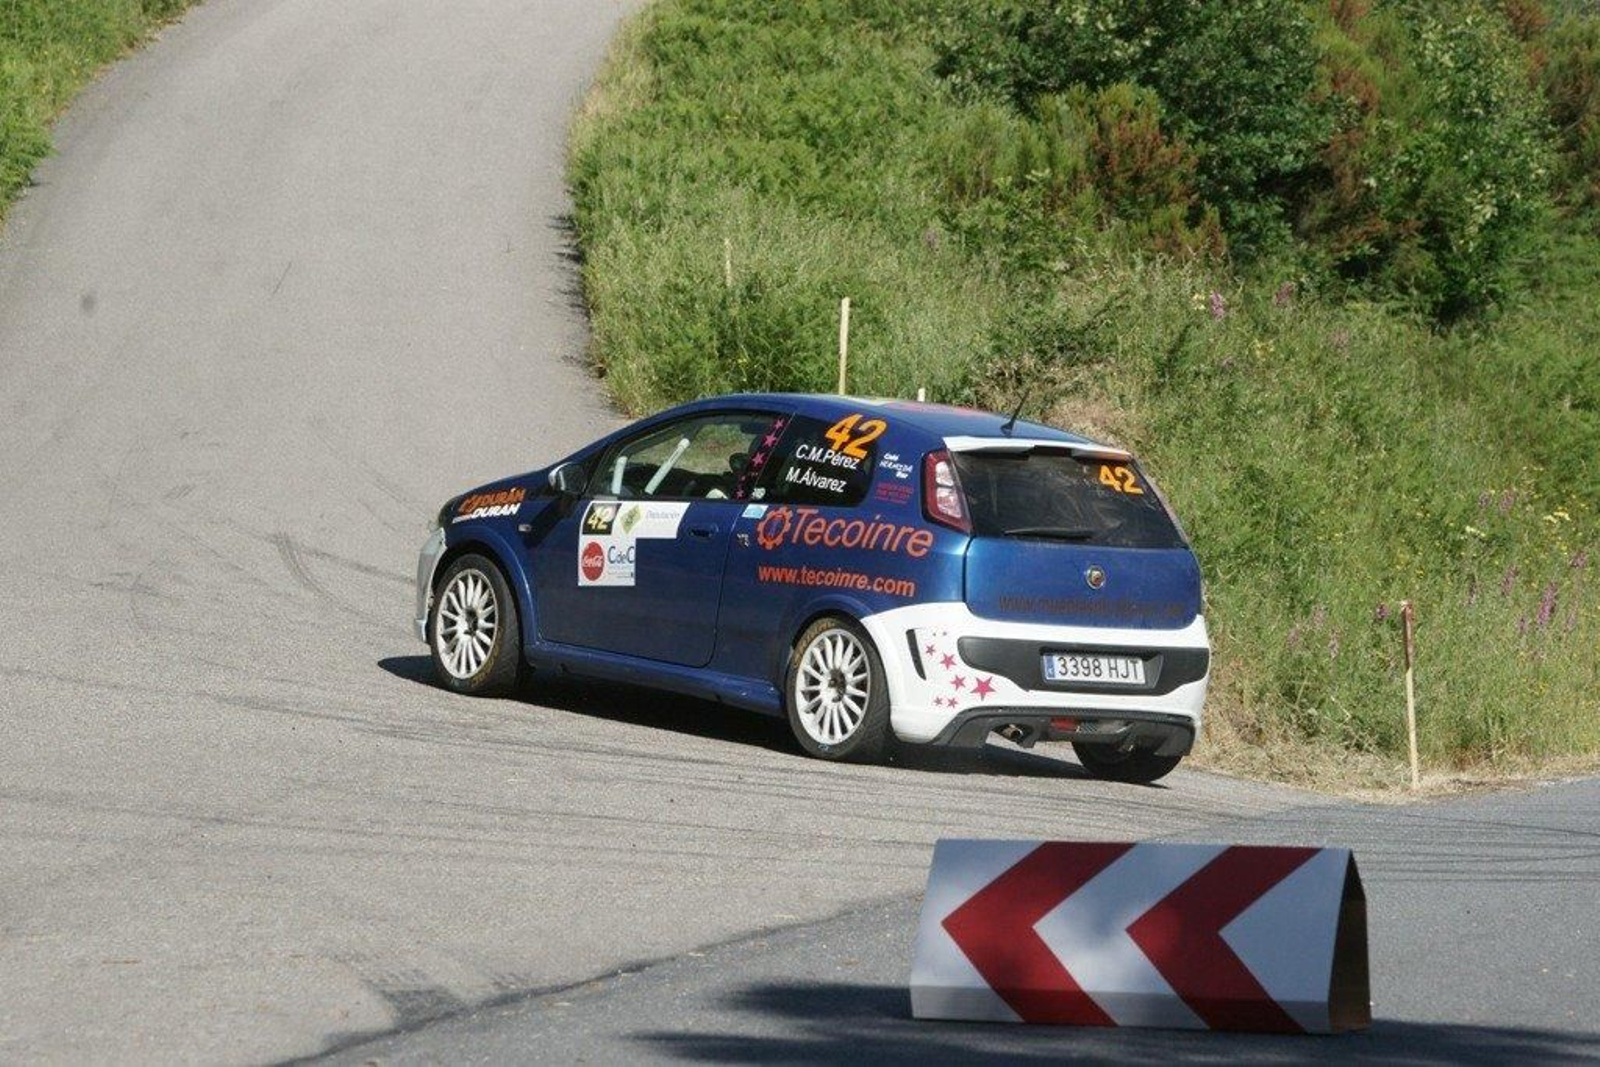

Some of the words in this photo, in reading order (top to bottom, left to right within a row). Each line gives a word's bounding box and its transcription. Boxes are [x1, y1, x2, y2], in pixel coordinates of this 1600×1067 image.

[825, 413, 887, 459] 42
[795, 444, 861, 470] C.M.Pérez
[785, 466, 847, 493] M.Álvarez
[1099, 465, 1144, 494] 42
[791, 507, 934, 557] Tecoinre
[757, 565, 916, 597] www.tecoinre.com
[1057, 656, 1103, 678] 3398
[1107, 658, 1140, 681] HJT
